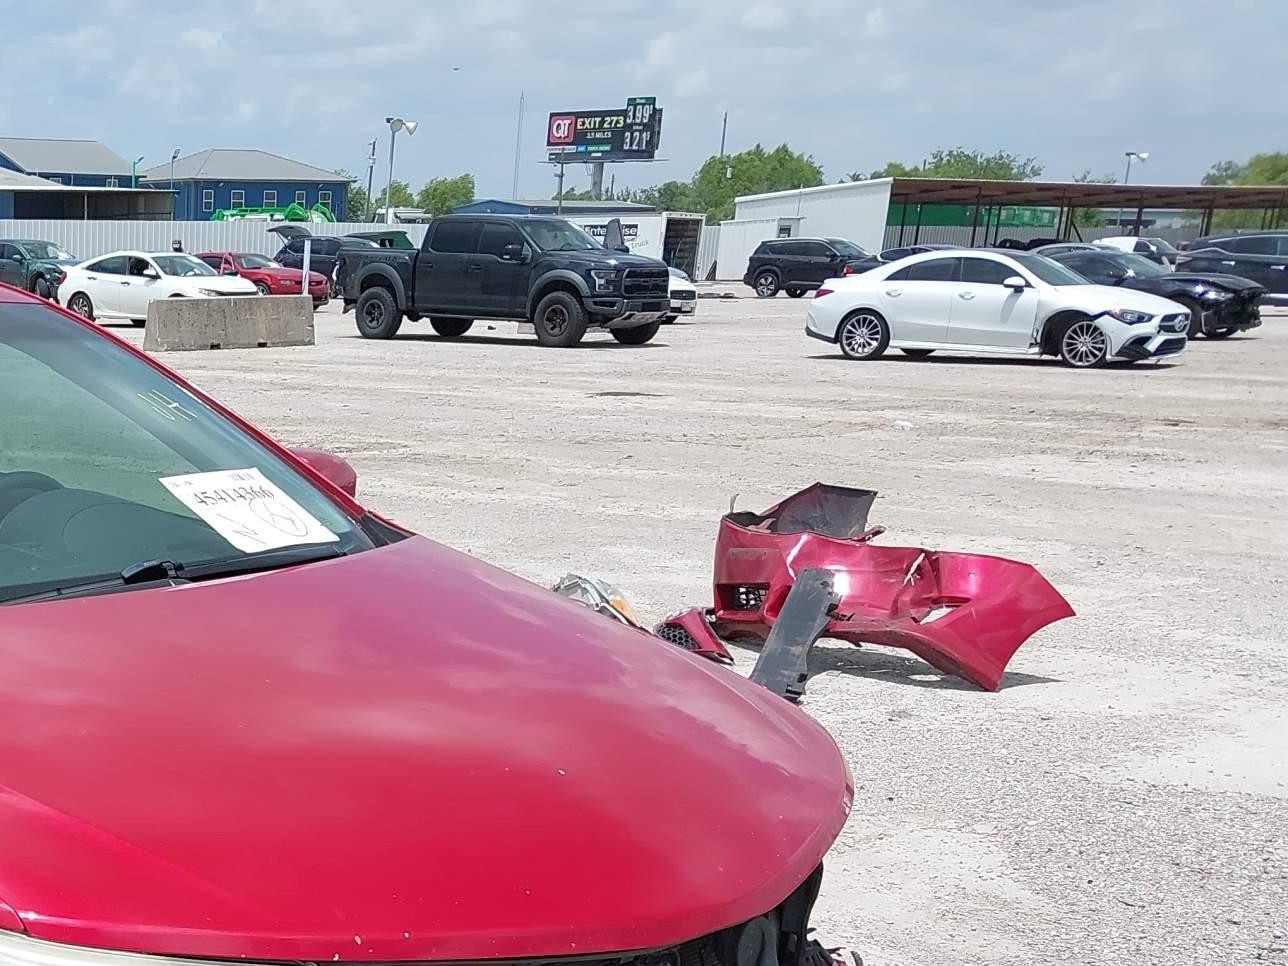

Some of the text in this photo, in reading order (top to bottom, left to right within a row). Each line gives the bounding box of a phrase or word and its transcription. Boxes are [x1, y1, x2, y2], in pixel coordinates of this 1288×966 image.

[552, 119, 572, 139] QT
[576, 118, 601, 129] EXIT
[603, 116, 624, 128] 273
[584, 225, 637, 235] Enteise
[193, 485, 275, 507] 45414366
